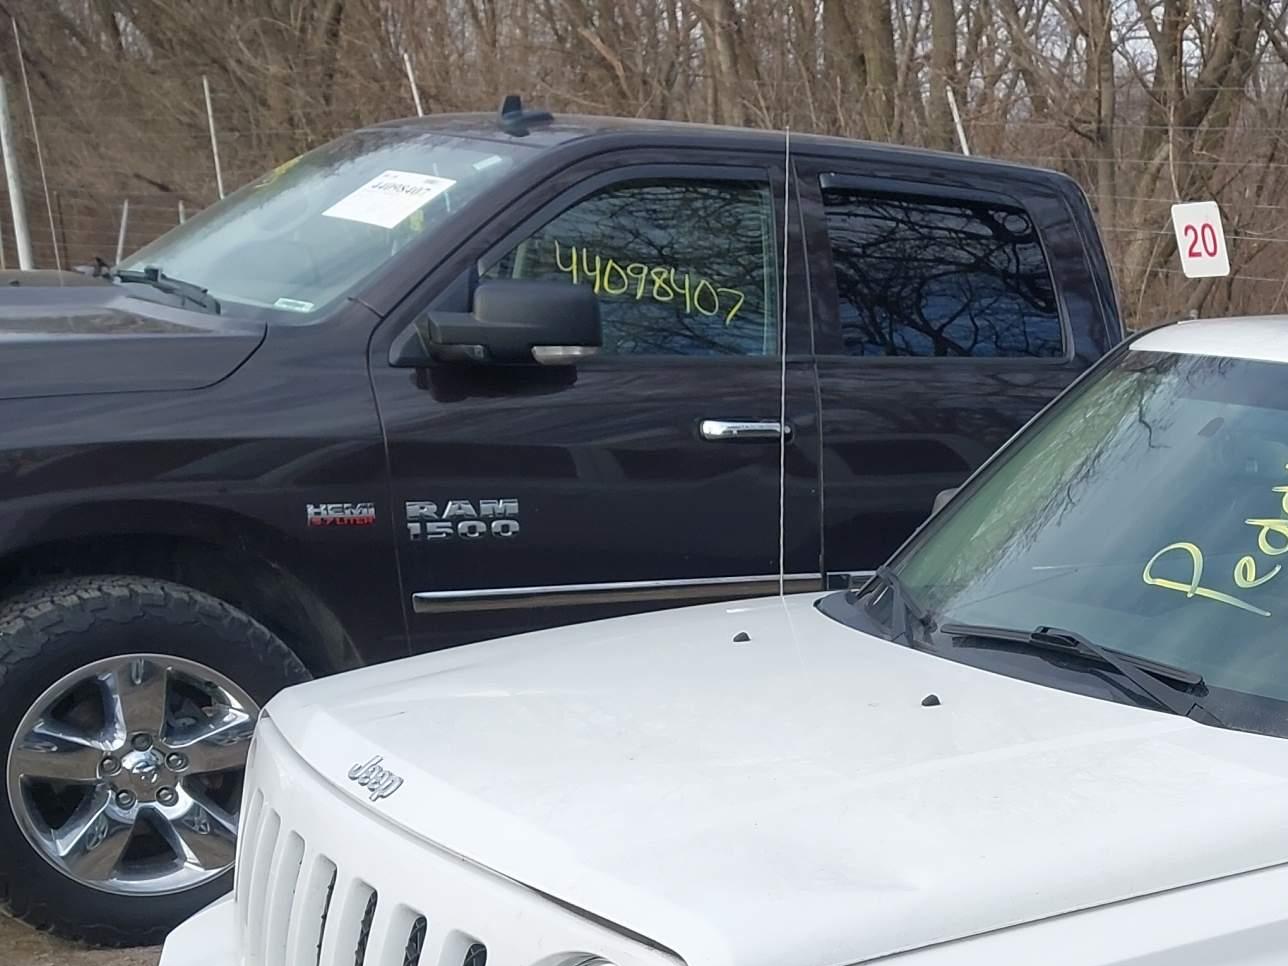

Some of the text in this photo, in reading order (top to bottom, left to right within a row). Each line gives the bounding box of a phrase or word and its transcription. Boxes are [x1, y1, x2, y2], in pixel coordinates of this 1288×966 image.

[1184, 223, 1217, 258] 20
[555, 240, 744, 326] 44098407
[306, 503, 375, 516] HEMI
[405, 499, 519, 520] RAM
[406, 519, 520, 541] 1500
[347, 754, 405, 802] Jeep
